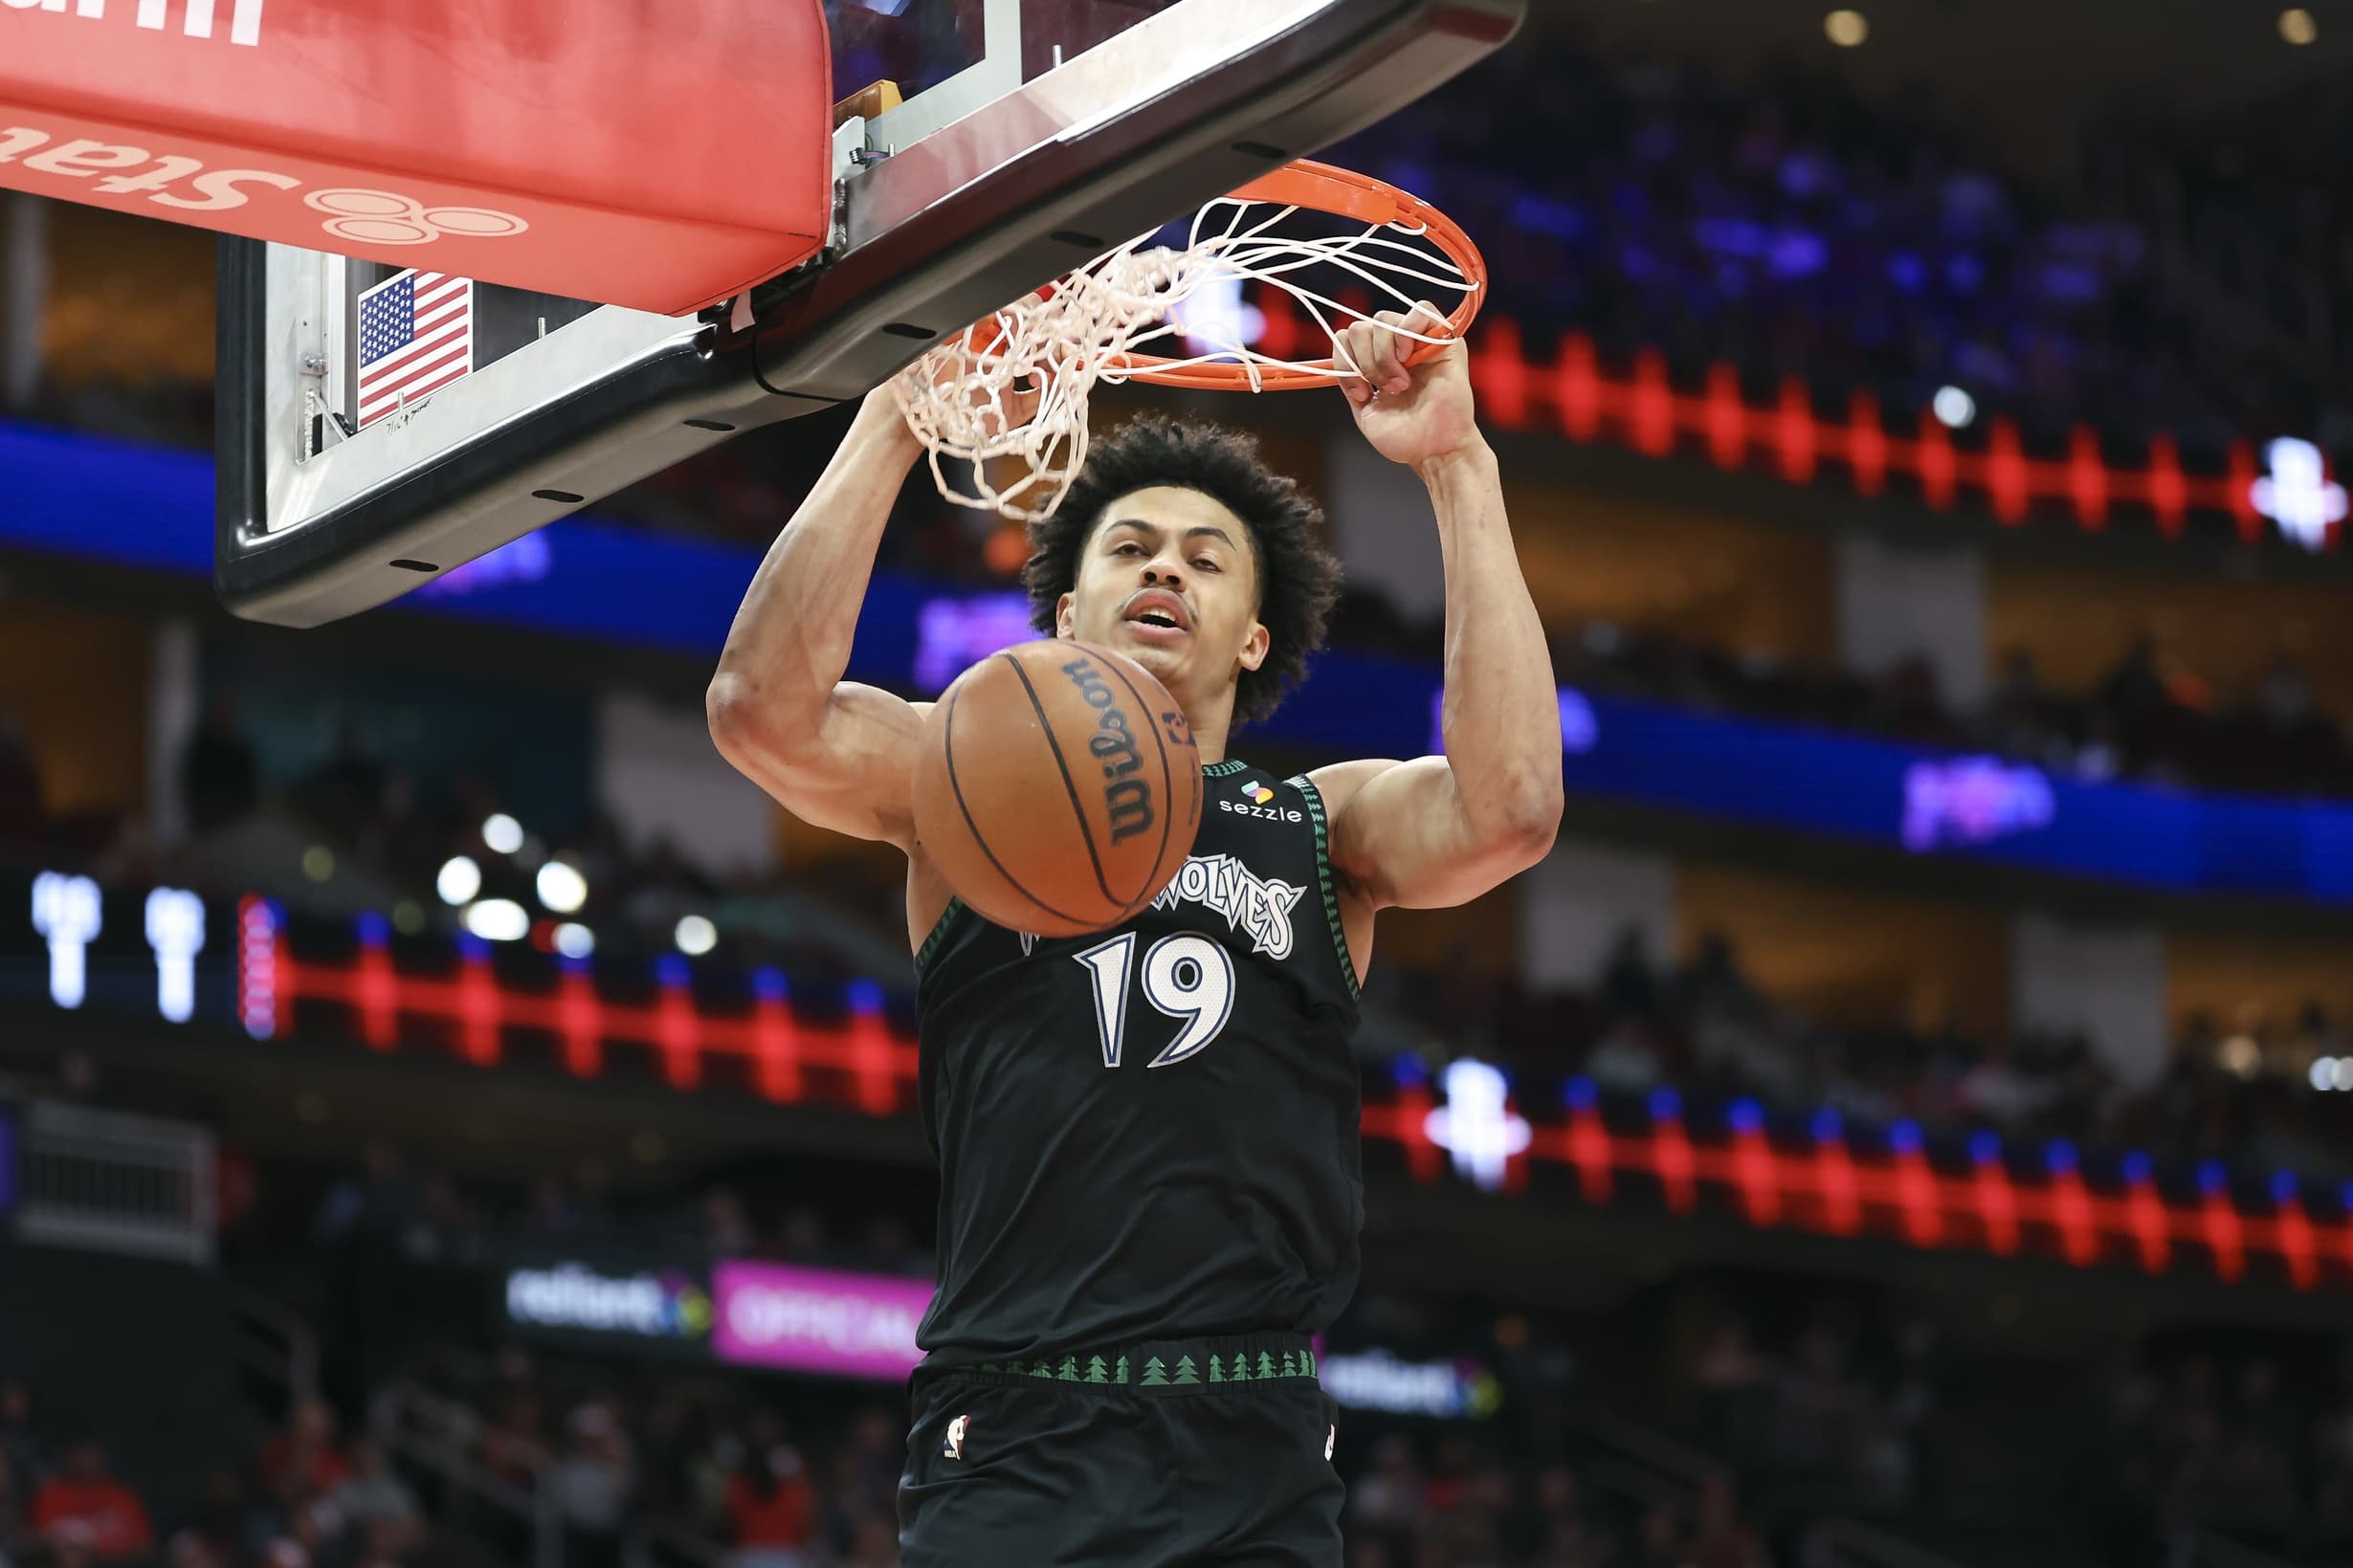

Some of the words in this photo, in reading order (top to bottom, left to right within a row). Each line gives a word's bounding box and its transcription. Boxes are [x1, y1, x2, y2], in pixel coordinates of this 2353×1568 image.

[1061, 657, 1154, 848] Wilson
[1218, 800, 1302, 823] sezzle
[1072, 931, 1235, 1068] 19
